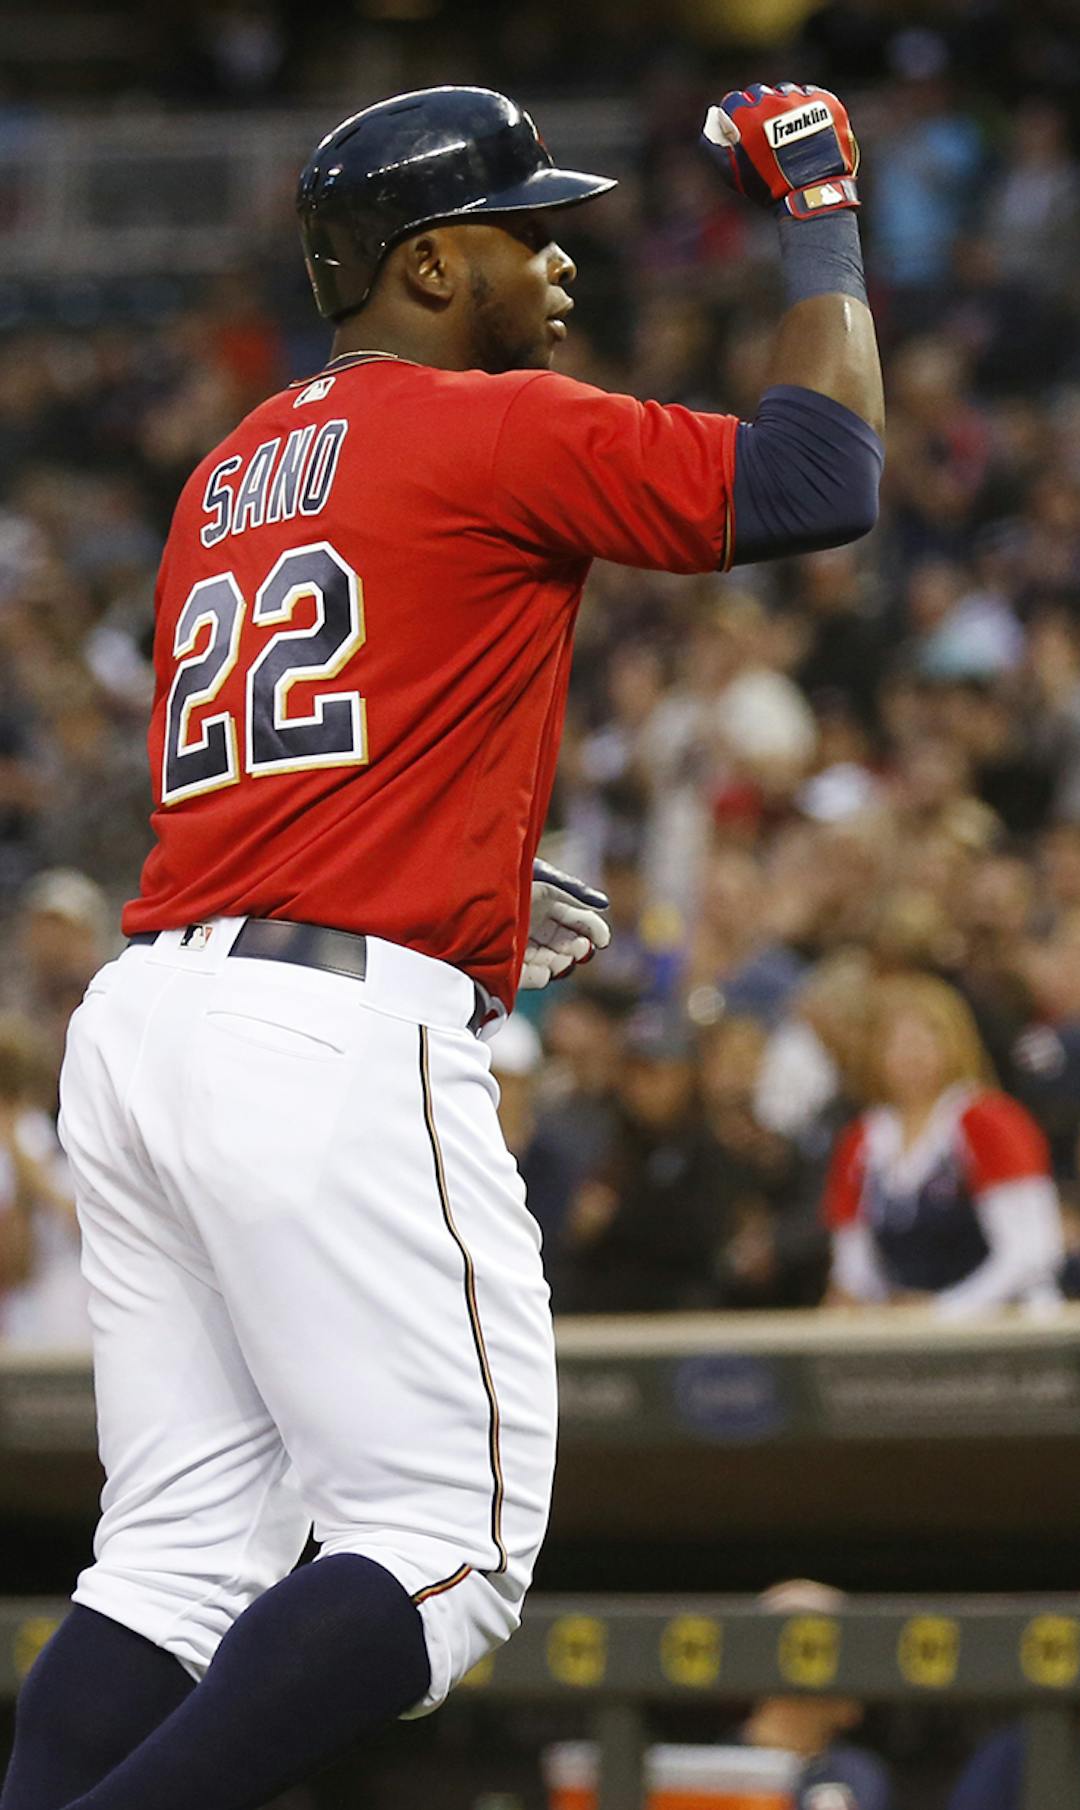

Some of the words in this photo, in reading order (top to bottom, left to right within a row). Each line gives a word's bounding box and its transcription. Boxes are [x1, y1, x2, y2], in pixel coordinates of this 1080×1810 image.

[772, 107, 829, 145] Franklin
[200, 418, 348, 548] SANO
[161, 540, 369, 806] 22
